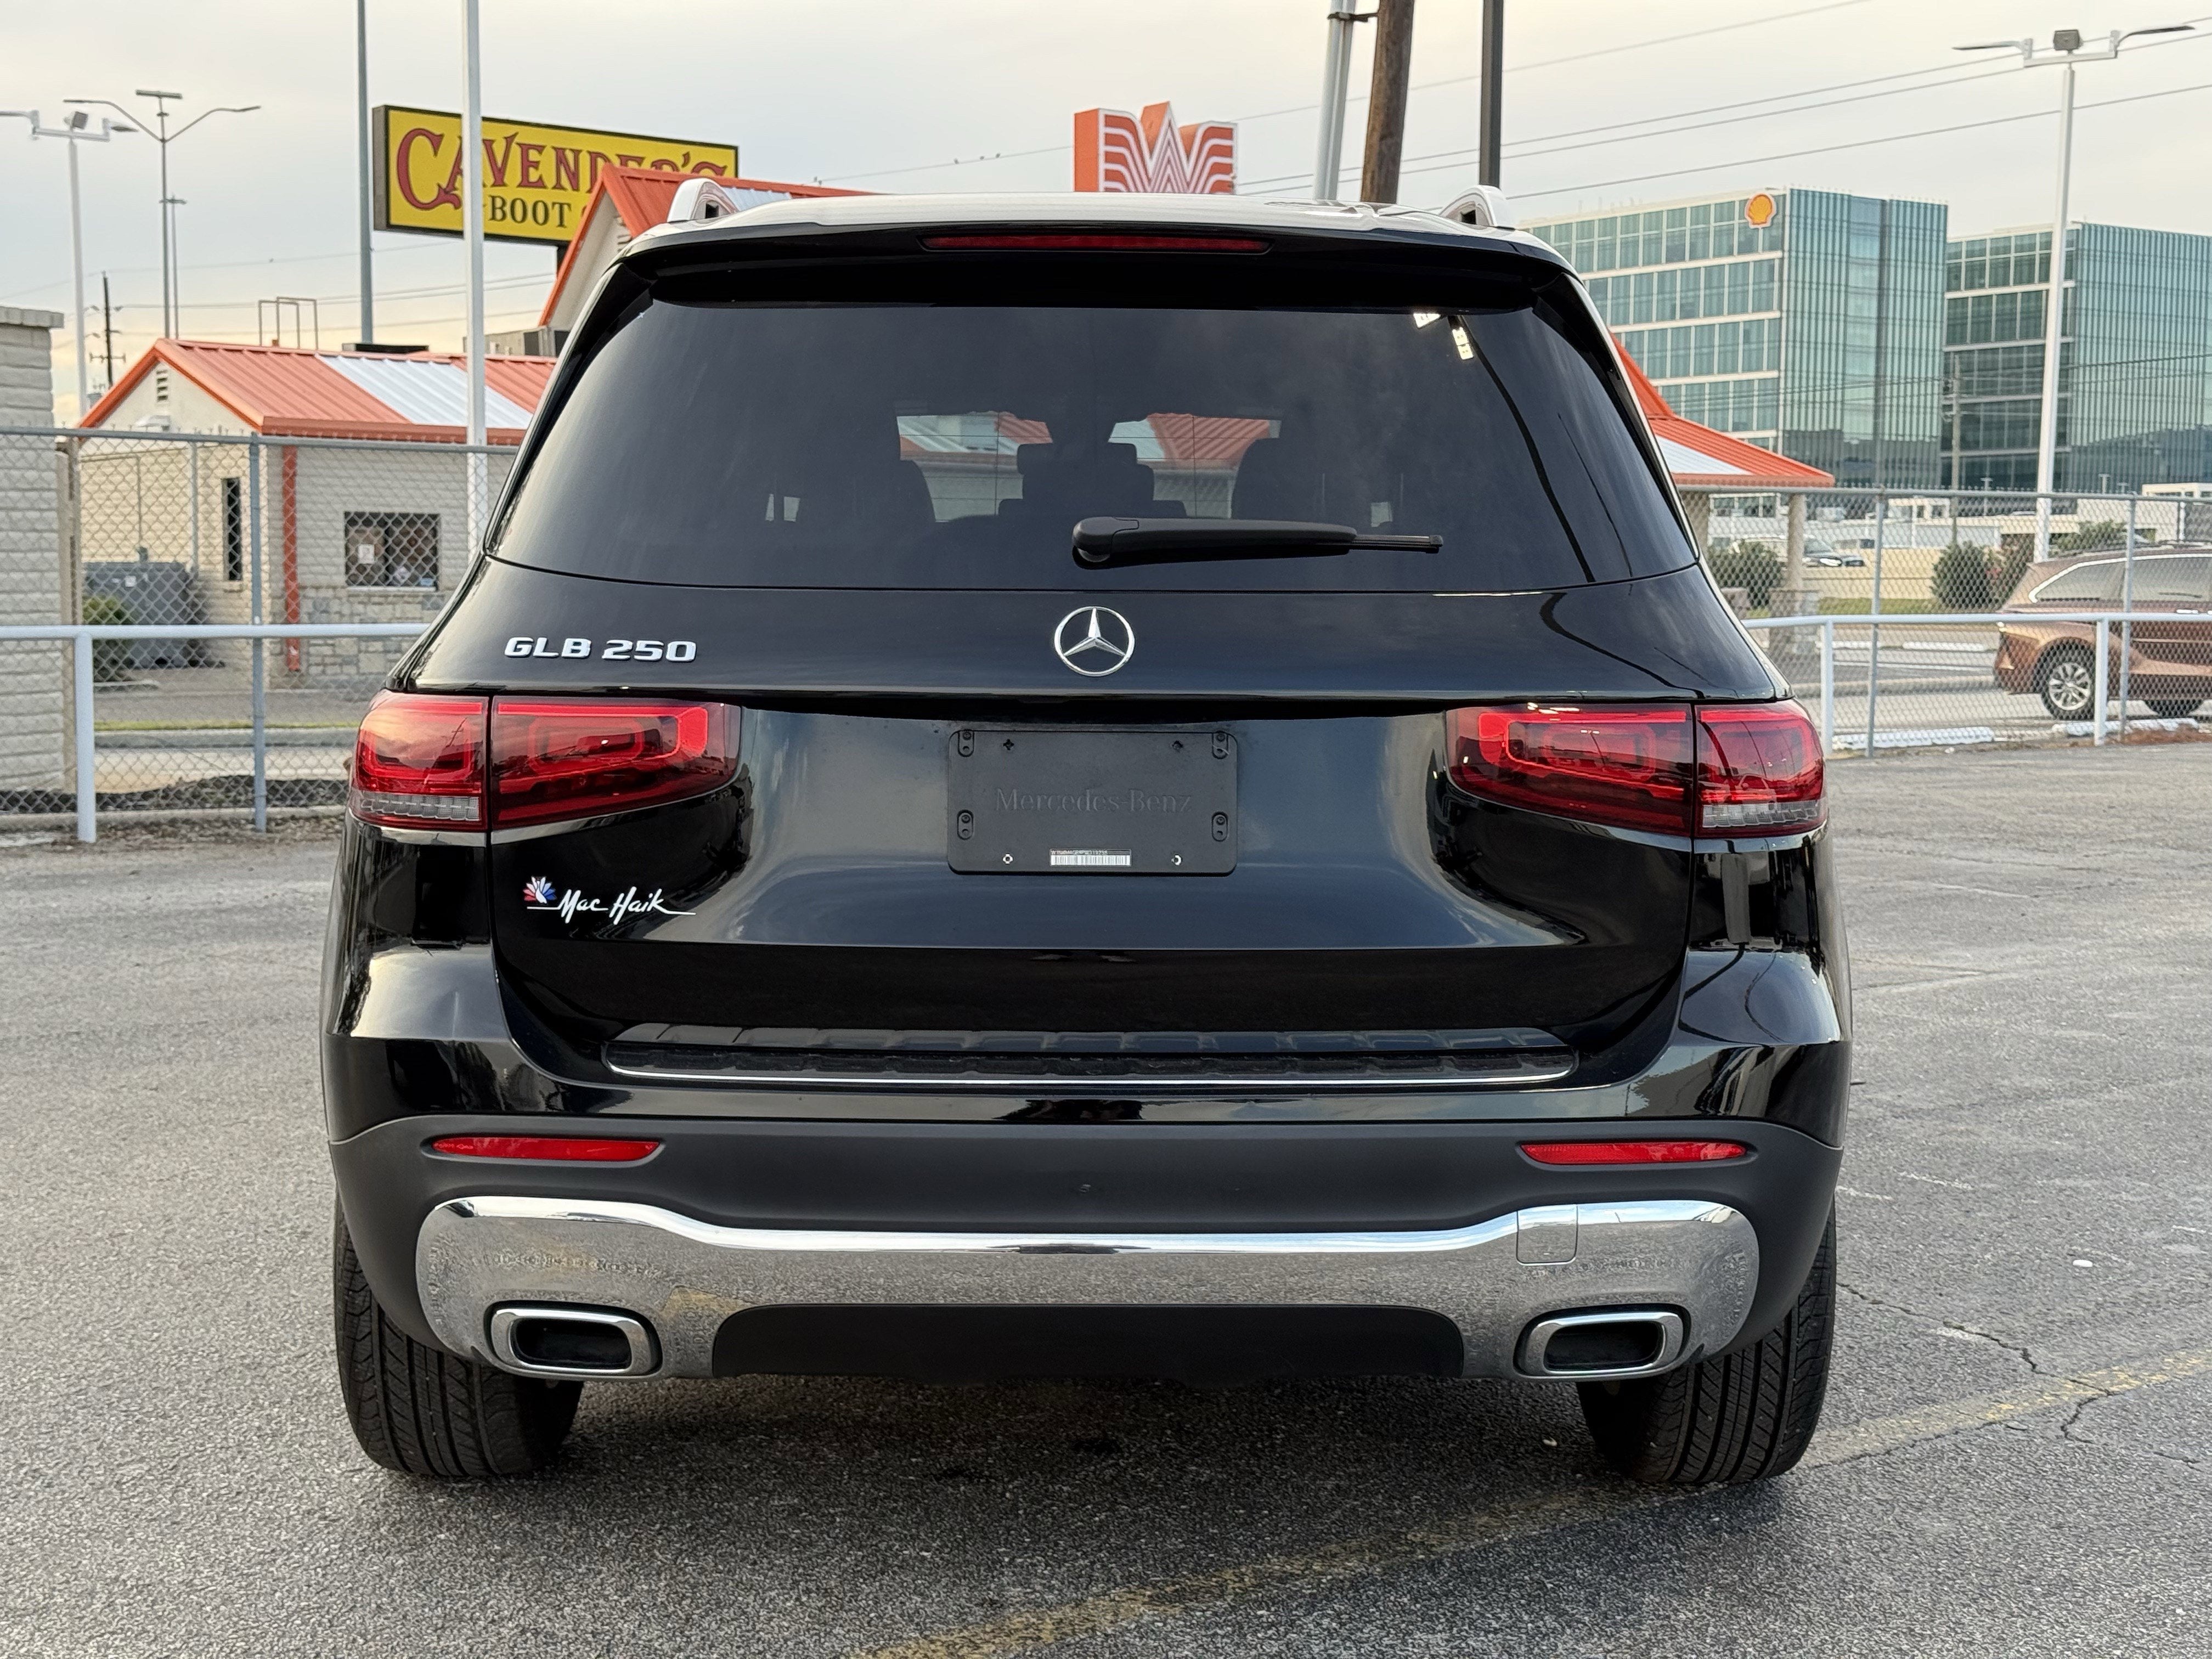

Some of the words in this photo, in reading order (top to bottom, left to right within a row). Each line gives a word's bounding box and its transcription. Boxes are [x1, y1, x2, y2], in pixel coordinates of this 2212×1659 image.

[397, 128, 728, 210] CAVEND'
[488, 195, 572, 228] BOOT
[504, 636, 592, 658] GLB
[601, 639, 697, 662] 250
[994, 787, 1192, 813] Mercedes-Benz
[543, 888, 609, 924] Mac
[609, 886, 688, 926] Haik
